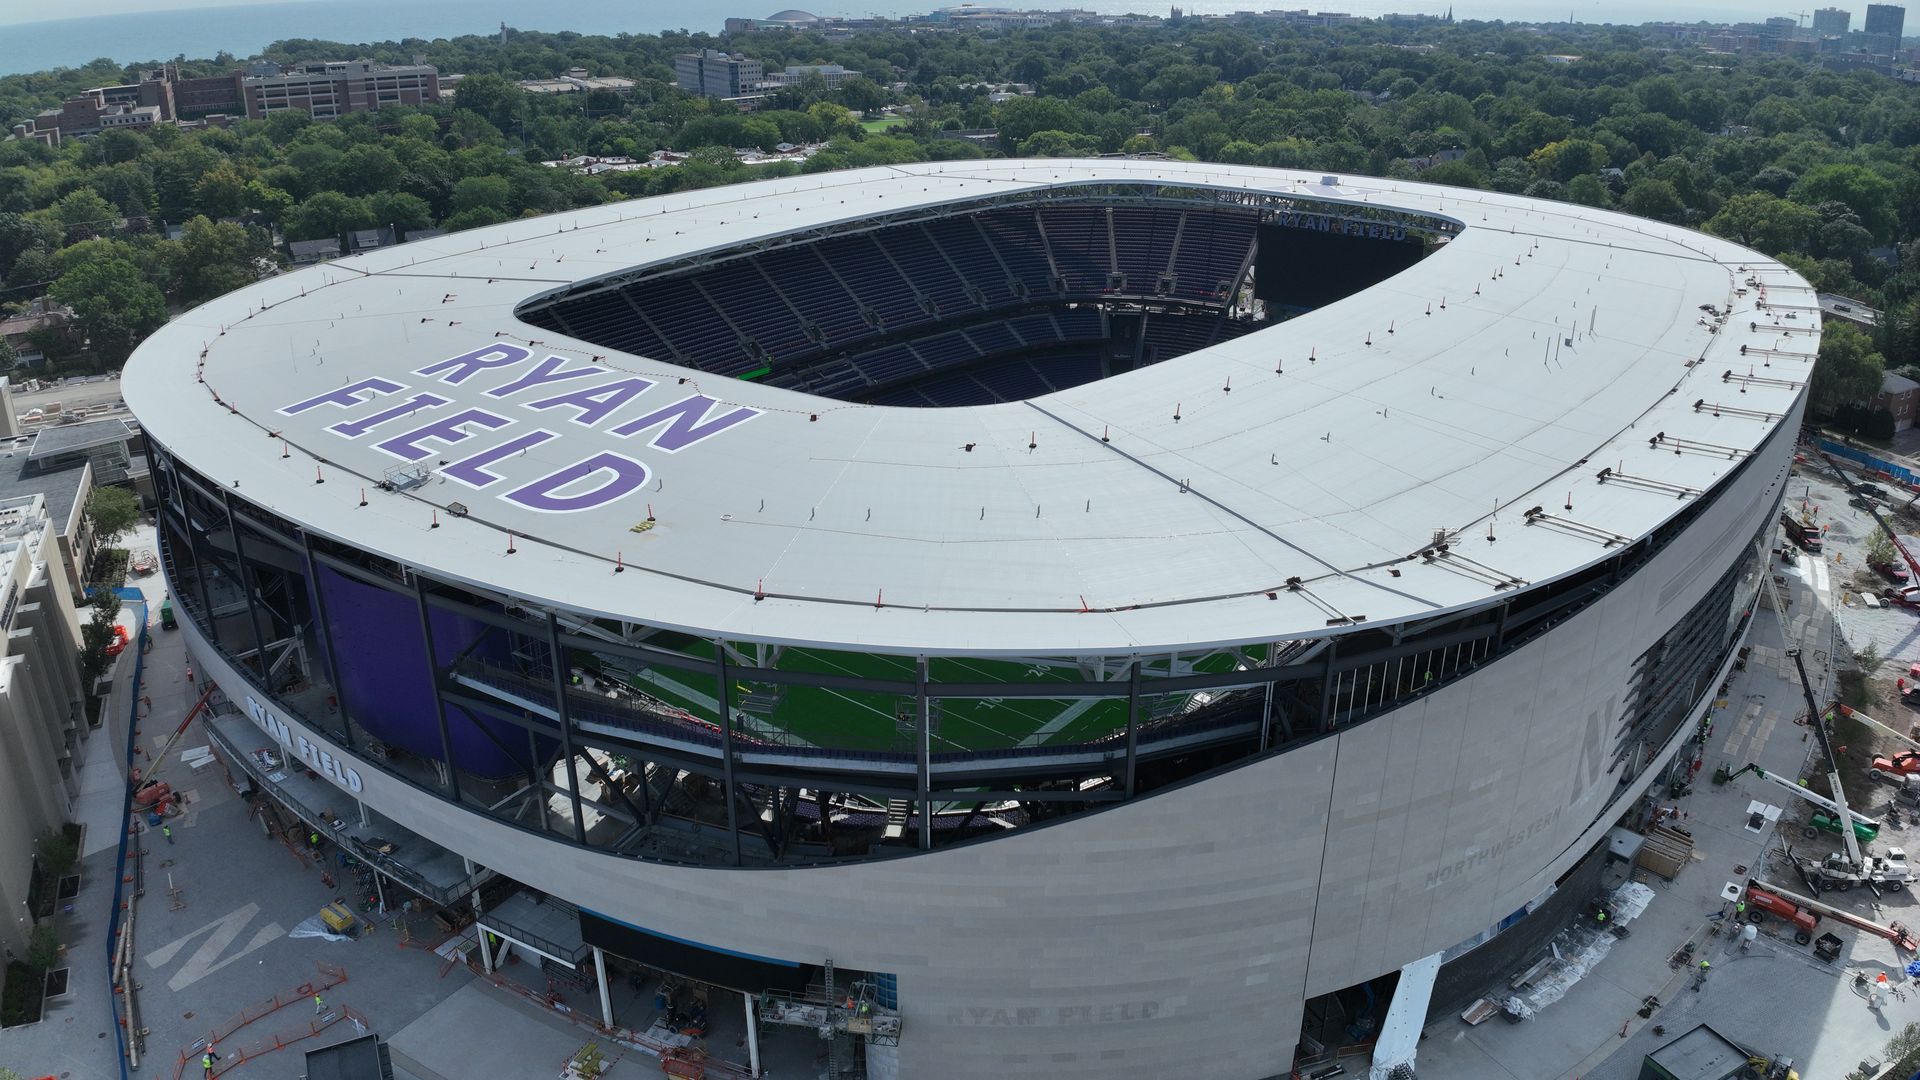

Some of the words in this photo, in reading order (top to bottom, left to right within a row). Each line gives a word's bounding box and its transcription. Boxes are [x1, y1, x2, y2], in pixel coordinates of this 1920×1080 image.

[1278, 212, 1330, 233] RYAN
[1343, 221, 1407, 241] FIELD
[410, 342, 767, 454] RYAN
[274, 375, 653, 514] FIELD
[246, 696, 294, 748] RYAN
[298, 736, 364, 793] FIELD
[1425, 805, 1562, 887] NORTHWESTERN
[947, 1007, 1039, 1026] RYAN
[1059, 1001, 1160, 1025] FIELD
